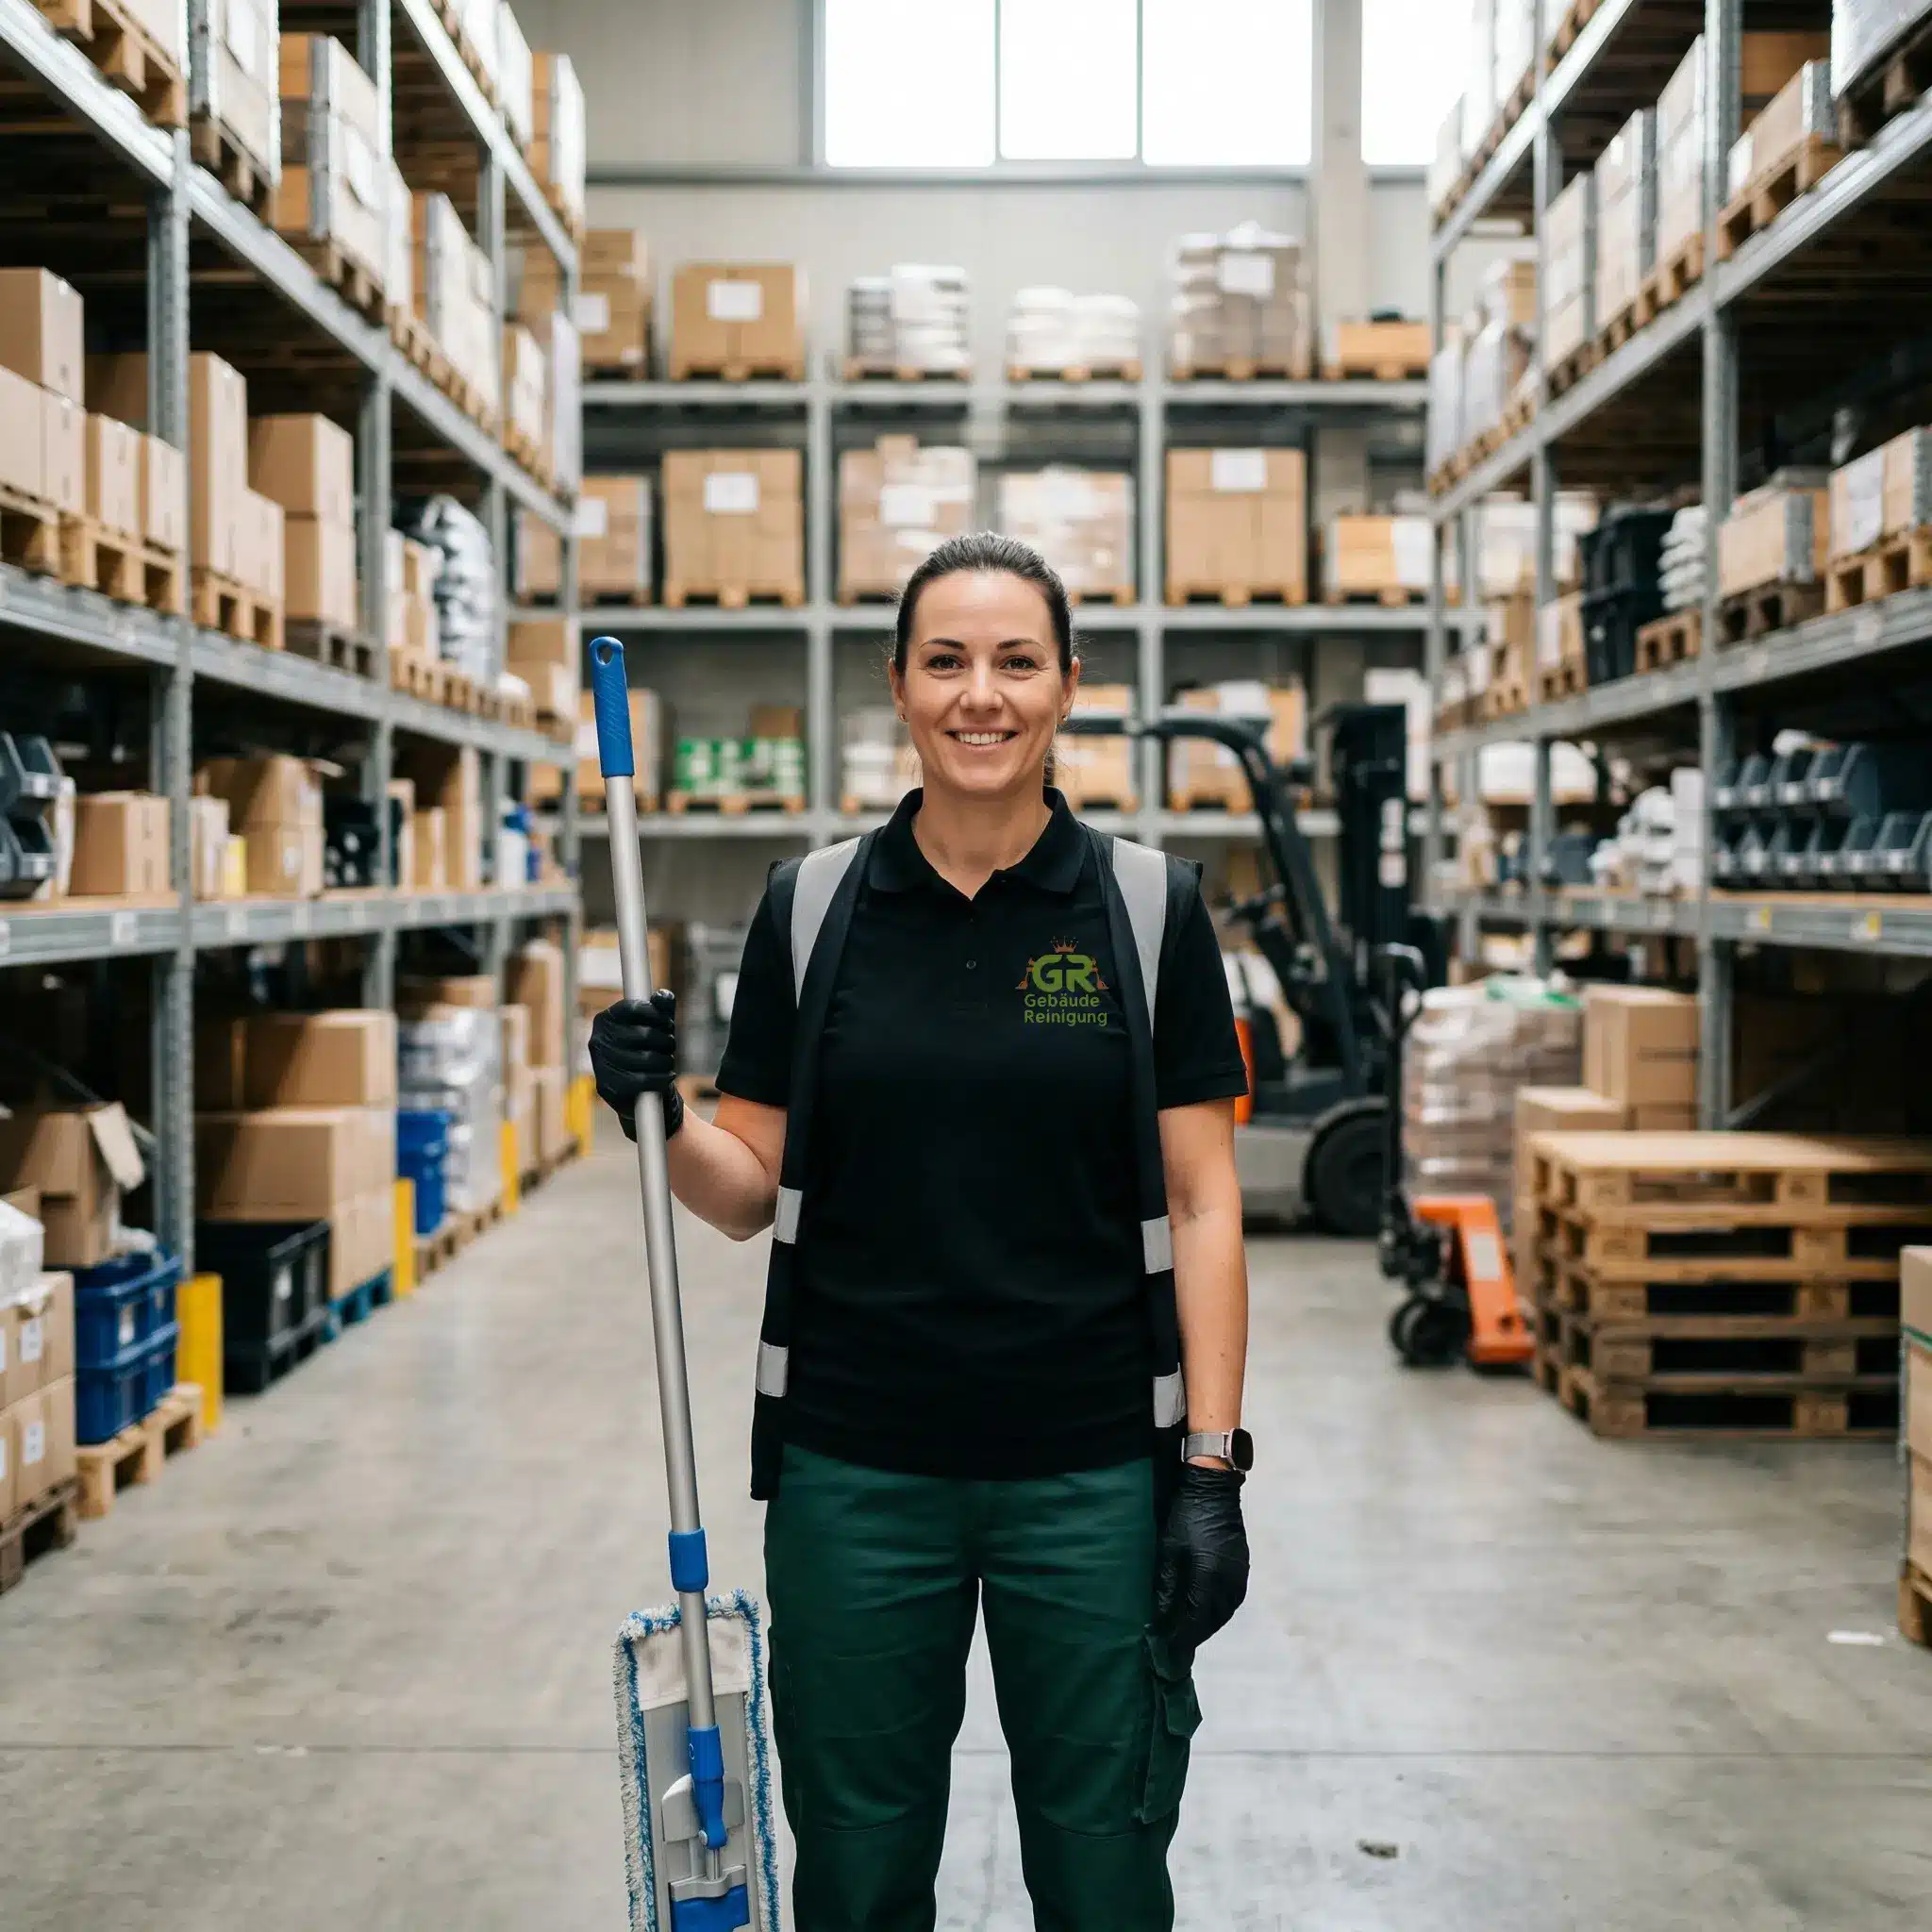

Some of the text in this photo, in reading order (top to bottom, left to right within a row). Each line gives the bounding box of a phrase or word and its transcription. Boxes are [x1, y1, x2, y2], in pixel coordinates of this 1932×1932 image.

[1032, 954, 1095, 992] GR
[1024, 993, 1100, 1008] Gebäude
[1024, 1009, 1108, 1026] Reinigung
